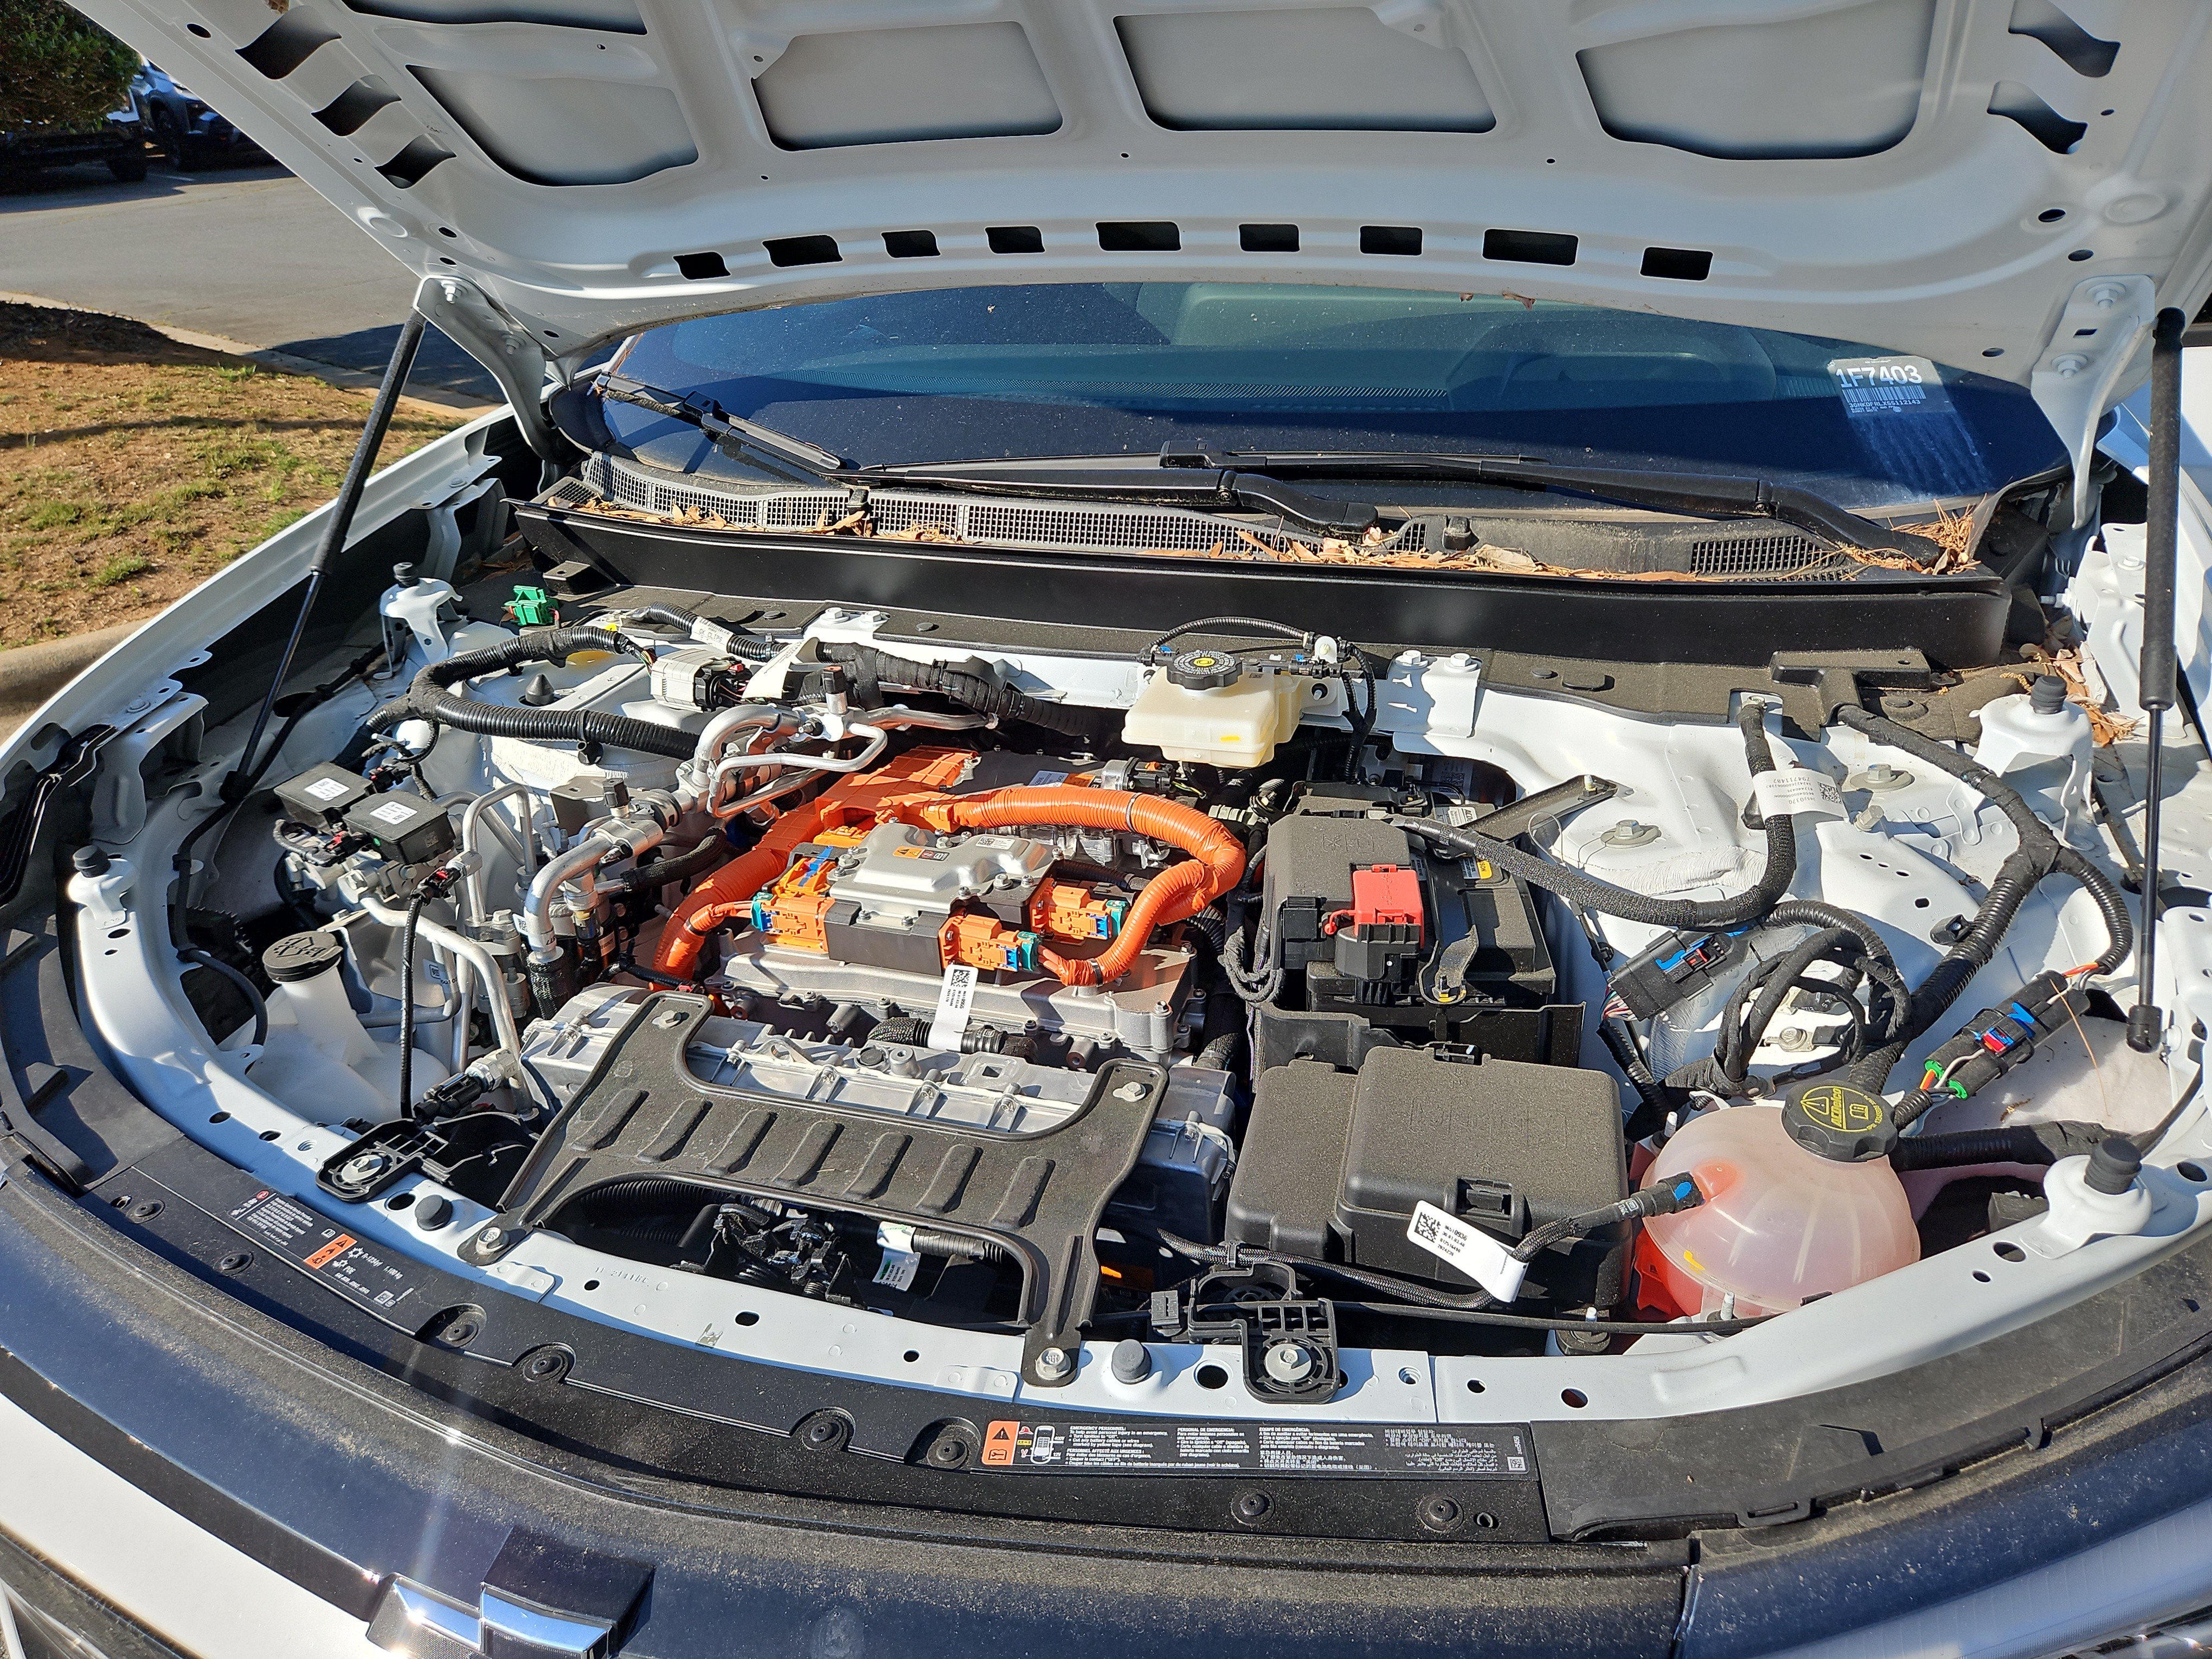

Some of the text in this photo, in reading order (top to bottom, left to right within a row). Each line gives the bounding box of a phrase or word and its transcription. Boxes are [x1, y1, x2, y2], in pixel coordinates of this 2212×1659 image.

[1836, 364, 1922, 388] 1F7403
[707, 633, 723, 642] CLIPS
[1832, 1087, 1842, 1127] ACDelco
[340, 1264, 357, 1275] POE
[391, 1271, 405, 1280] kg
